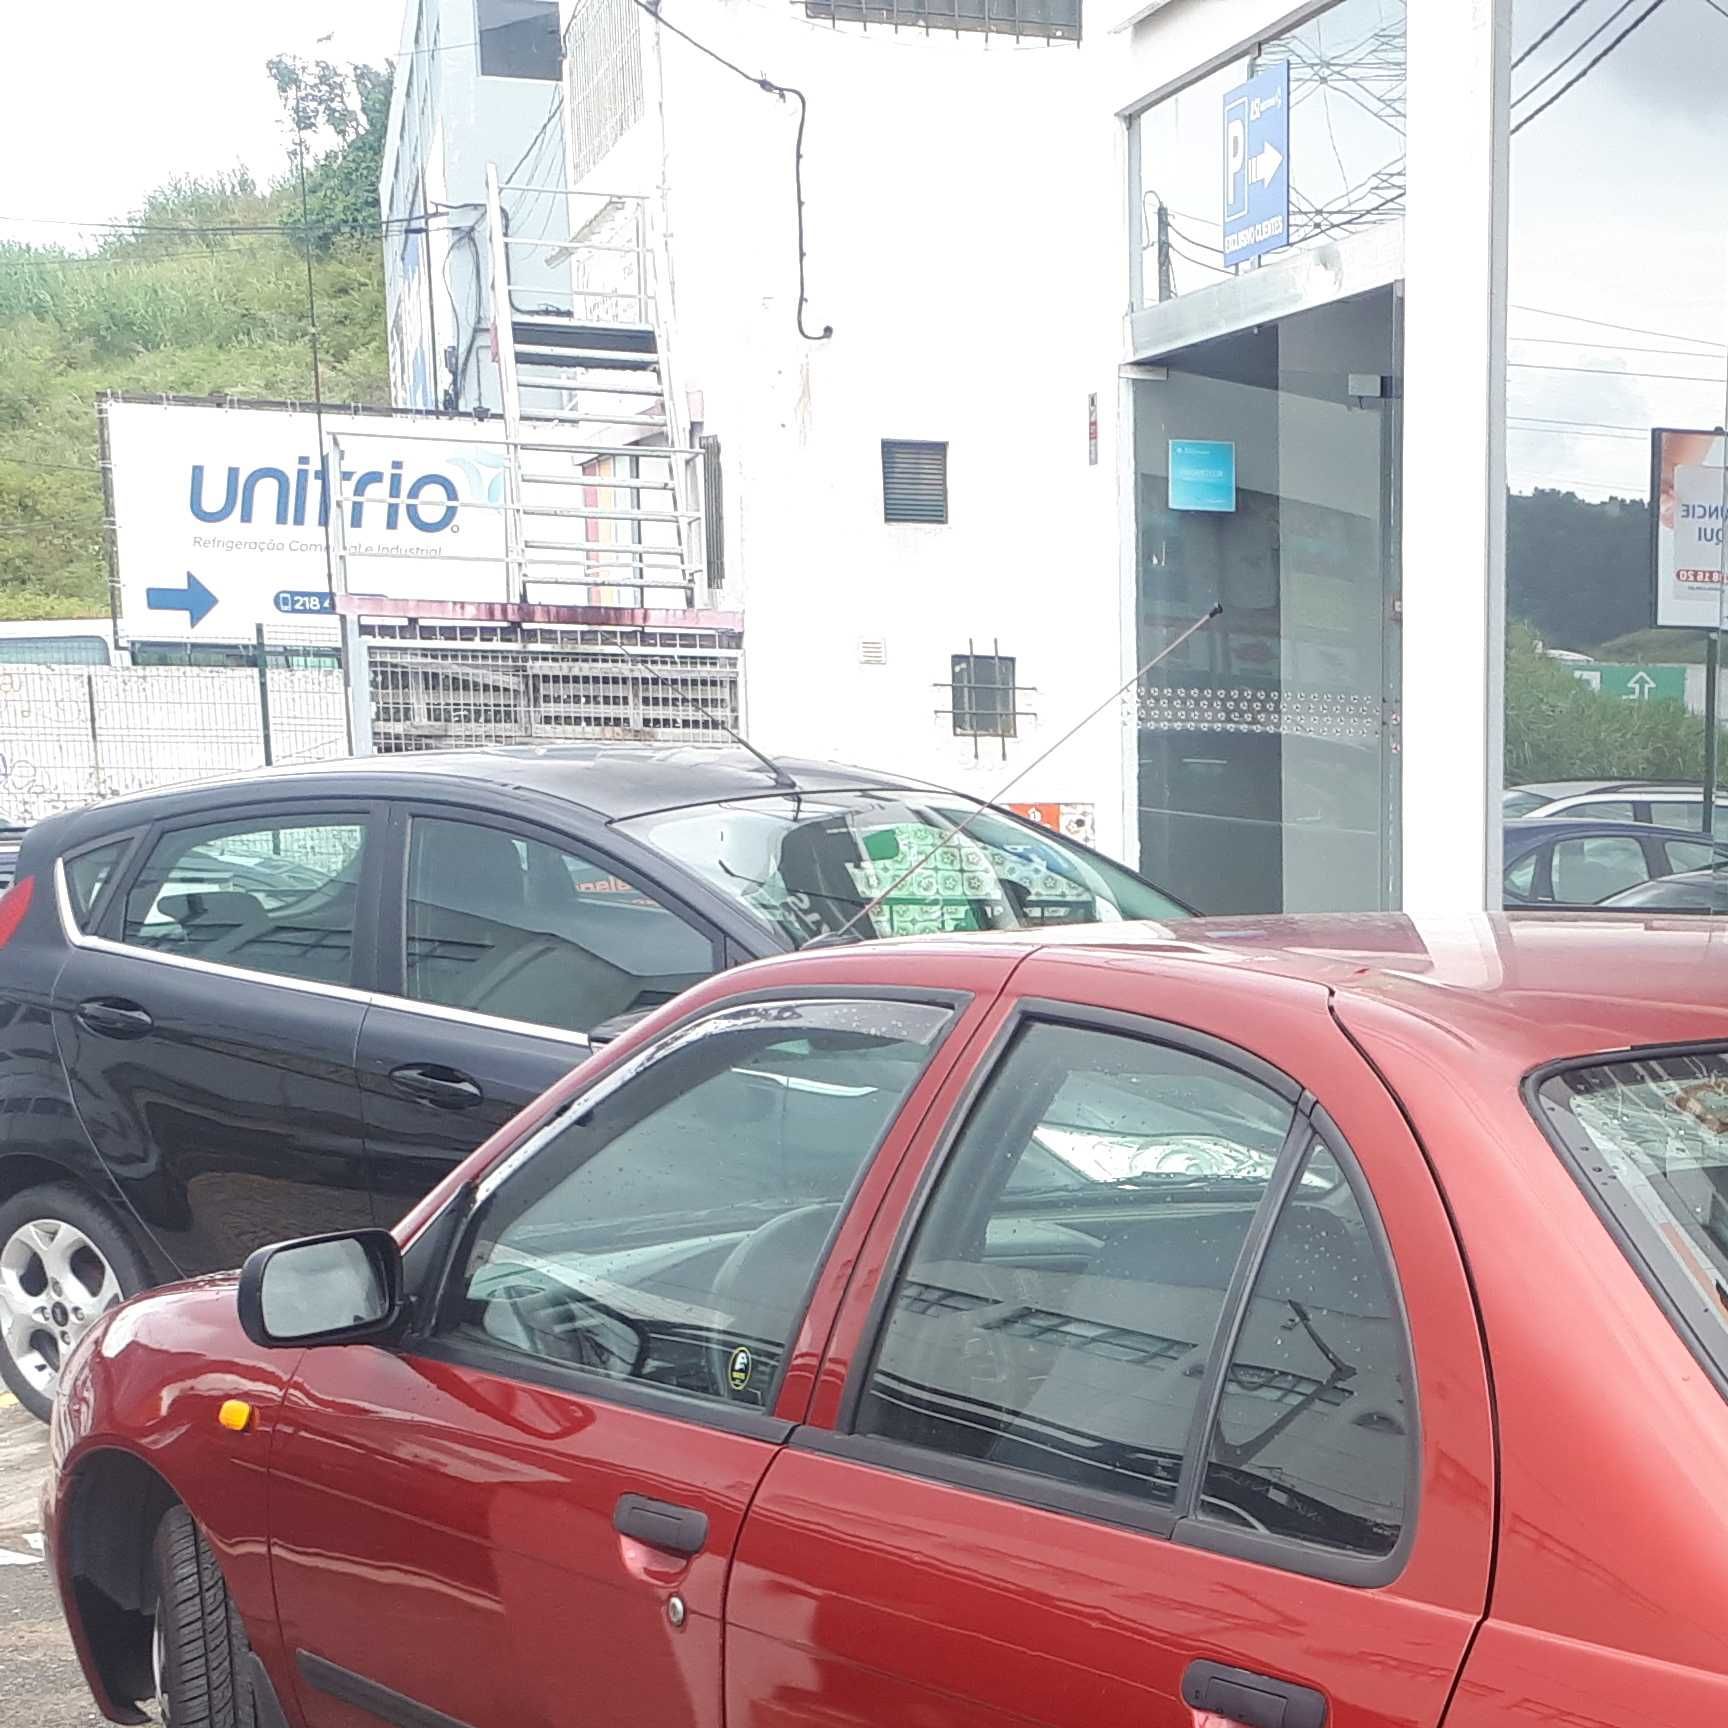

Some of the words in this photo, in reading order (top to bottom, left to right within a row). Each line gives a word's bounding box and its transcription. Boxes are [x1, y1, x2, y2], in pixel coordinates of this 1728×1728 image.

[1227, 118, 1245, 206] P
[190, 455, 460, 533] unifrio
[192, 535, 285, 552] Refrigeração
[293, 596, 321, 610] 218
